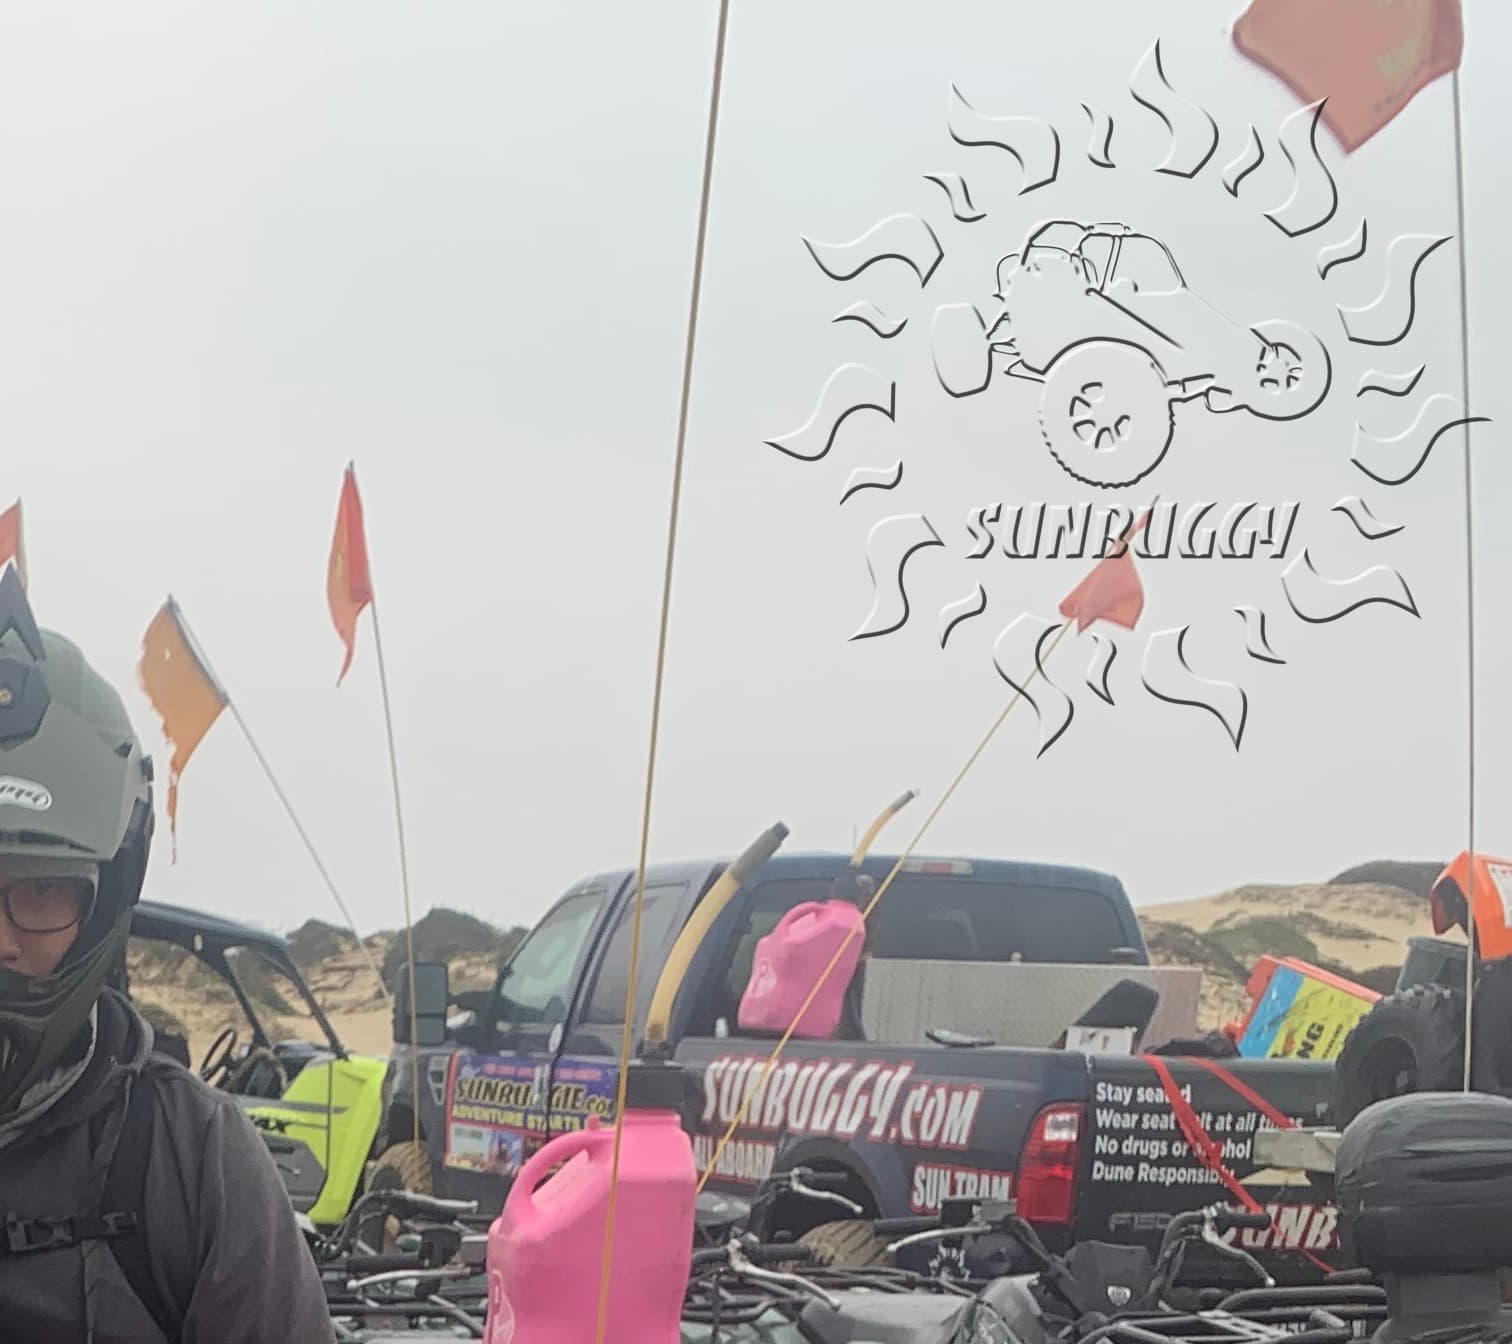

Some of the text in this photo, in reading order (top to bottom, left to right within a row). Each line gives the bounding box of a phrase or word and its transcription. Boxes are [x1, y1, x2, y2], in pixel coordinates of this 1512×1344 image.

[702, 1056, 985, 1148] SUNBUGGY.COM
[1095, 1081, 1192, 1106] Stay sead
[1095, 1108, 1140, 1130] Wear
[1141, 1111, 1177, 1131] seat
[1215, 1112, 1234, 1132] at
[1235, 1112, 1256, 1132] all
[1094, 1135, 1119, 1155] No
[1121, 1136, 1169, 1160] drugs
[1092, 1160, 1135, 1182] Dune
[911, 1163, 1011, 1212] SUN TRAM
